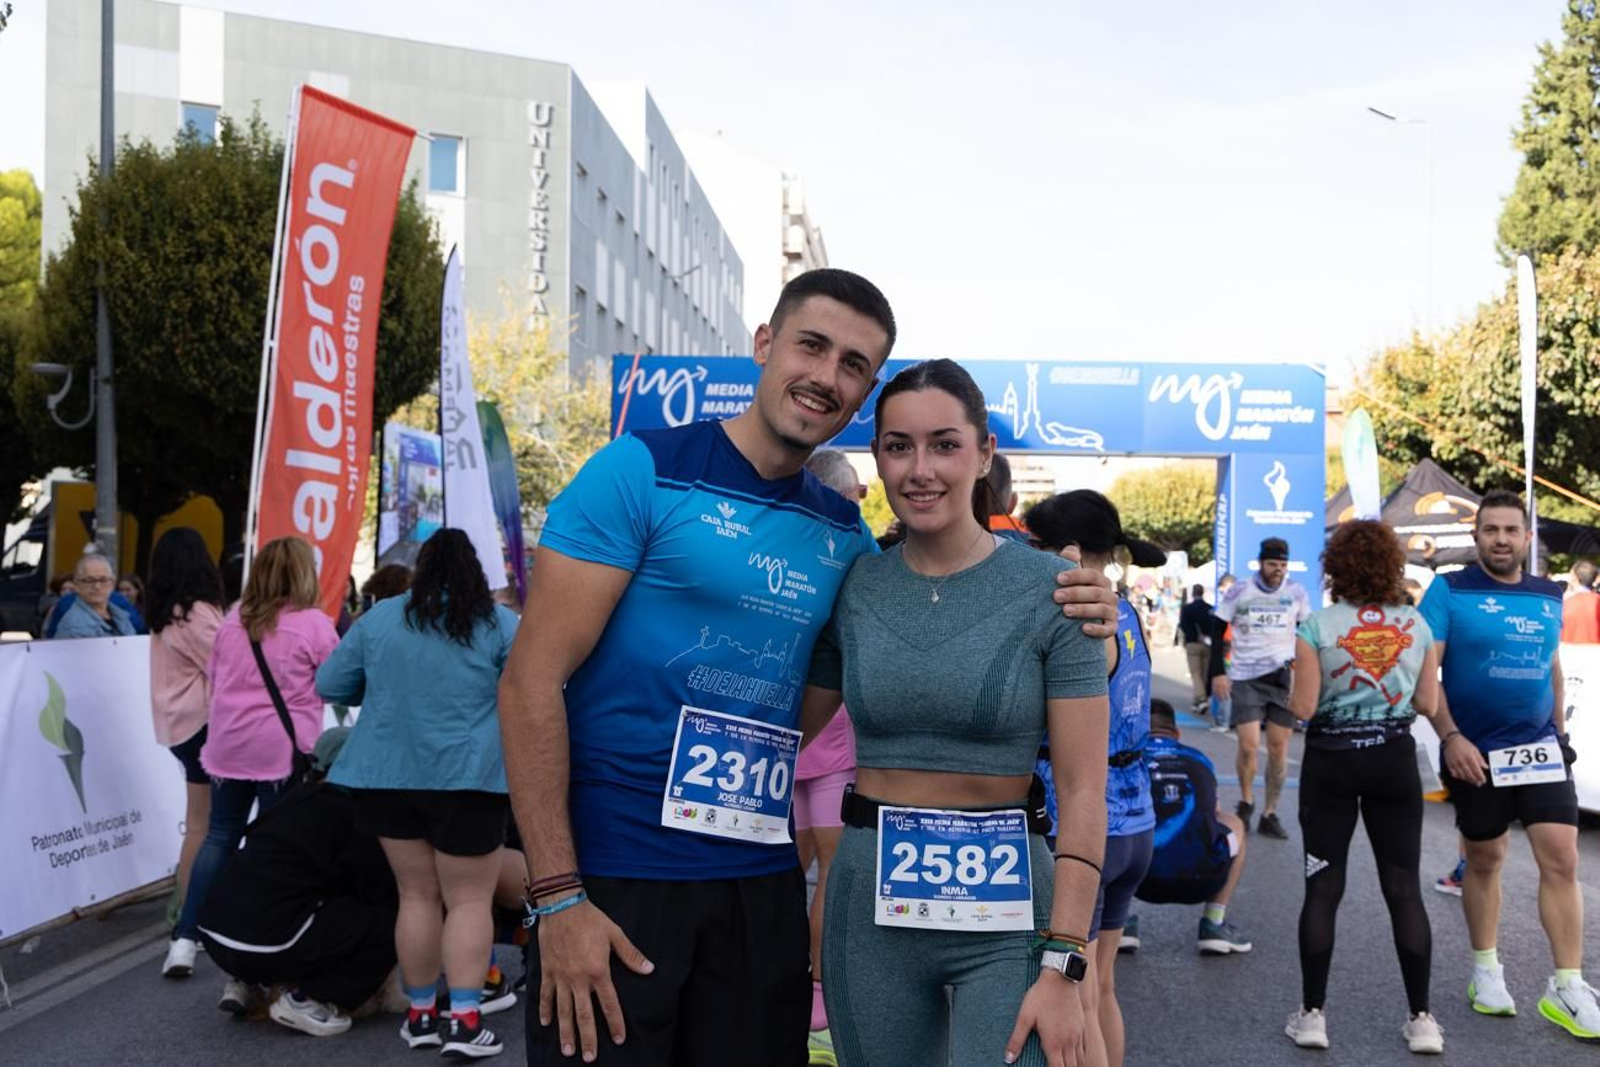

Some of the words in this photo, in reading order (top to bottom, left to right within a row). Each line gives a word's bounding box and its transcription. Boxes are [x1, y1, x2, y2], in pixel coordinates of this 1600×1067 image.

[344, 274, 365, 417] maestras
[286, 160, 356, 578] alderón
[705, 384, 753, 396] MEDIA
[701, 401, 752, 414] MARA
[701, 513, 721, 527] CAJA
[724, 520, 751, 535] RURAL
[716, 526, 738, 540] JAÉN
[787, 570, 808, 582] MEDIA
[781, 589, 798, 600] JAÉN
[785, 579, 816, 595] MARATÓN
[1258, 614, 1281, 625] 467
[1504, 747, 1548, 766] 736
[682, 744, 789, 801] 2310
[718, 792, 737, 803] JOSE
[740, 796, 763, 808] PABLO
[31, 826, 84, 852] Patronato
[84, 812, 128, 835] Municipal
[129, 810, 143, 823] de
[98, 838, 110, 854] de
[112, 831, 135, 849] Jaén
[889, 841, 1020, 885] 2582
[941, 886, 968, 896] INMA
